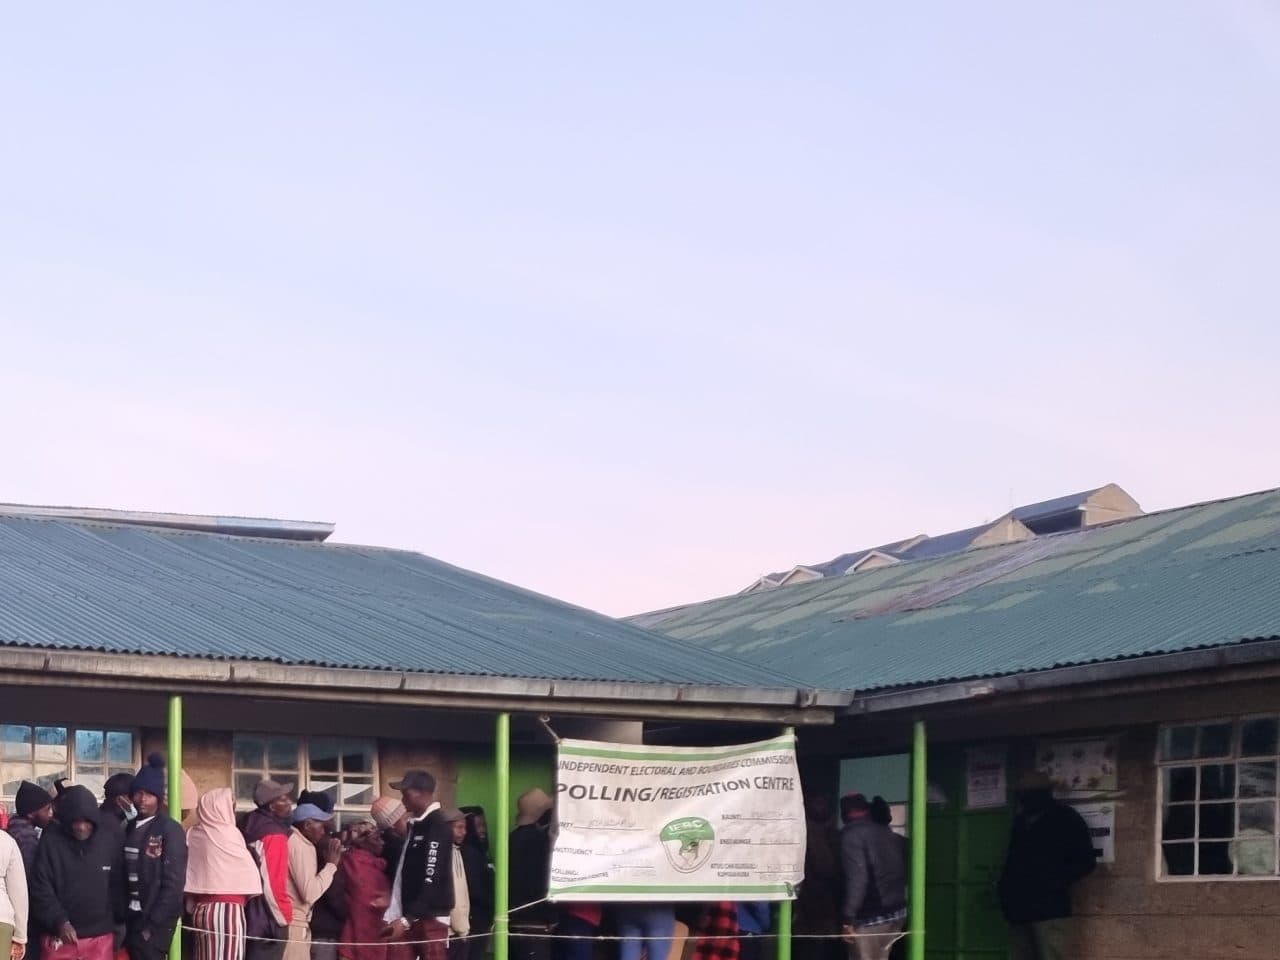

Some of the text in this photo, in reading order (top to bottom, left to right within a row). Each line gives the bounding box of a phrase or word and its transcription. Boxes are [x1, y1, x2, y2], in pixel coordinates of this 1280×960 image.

[559, 760, 629, 775] INDEPENDENT
[630, 766, 677, 776] ELECTORAL
[754, 776, 795, 791] CENTRE
